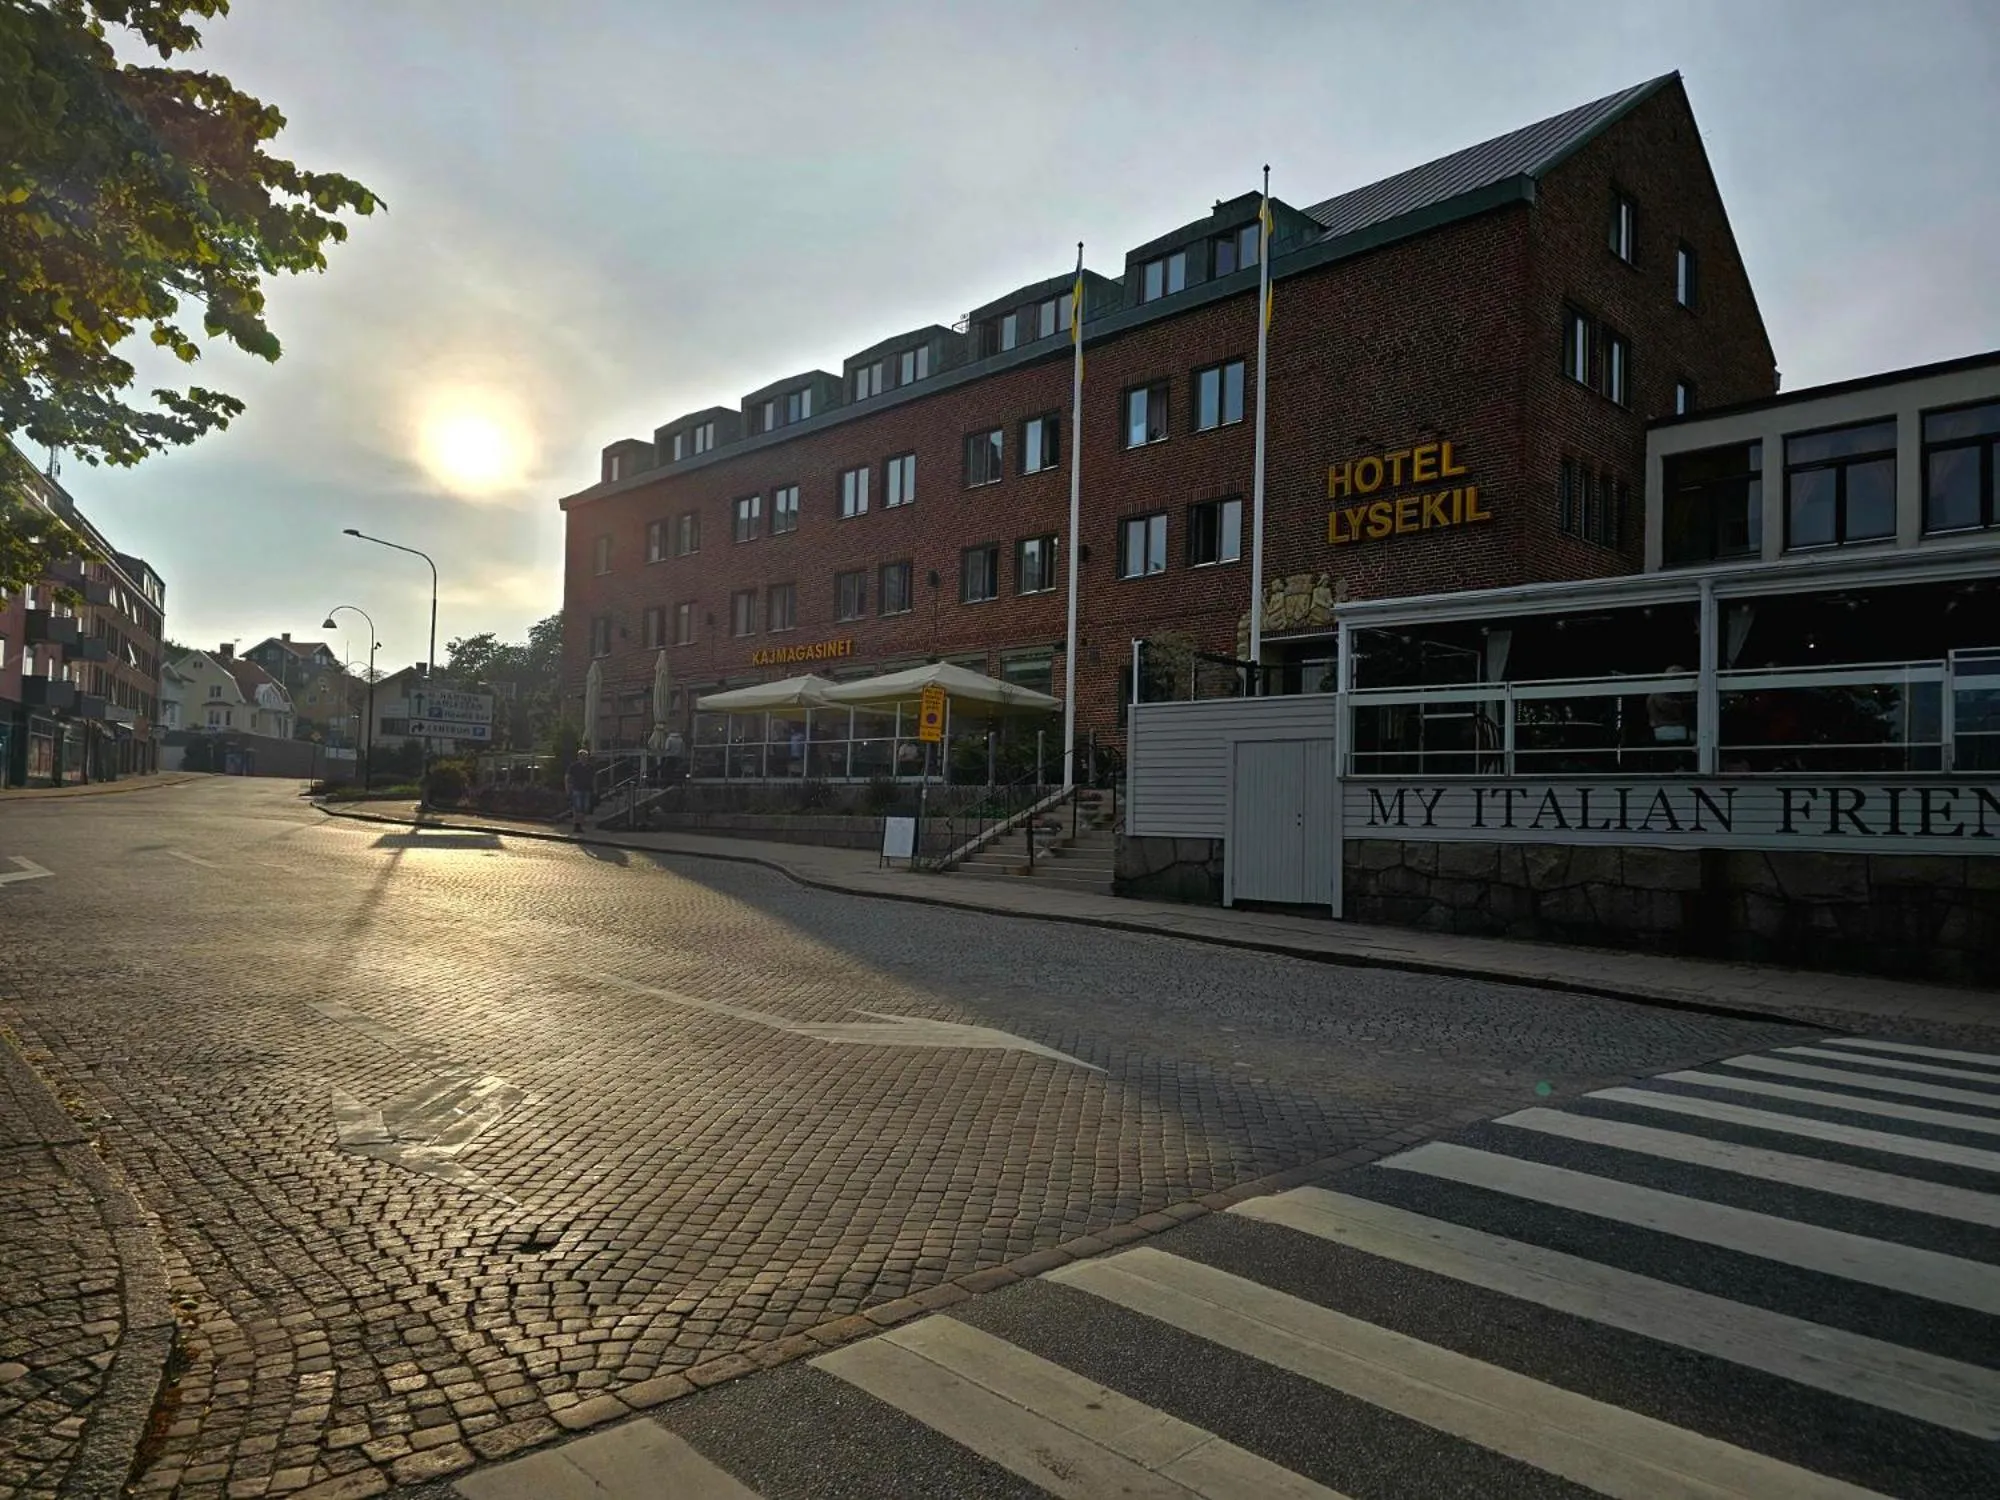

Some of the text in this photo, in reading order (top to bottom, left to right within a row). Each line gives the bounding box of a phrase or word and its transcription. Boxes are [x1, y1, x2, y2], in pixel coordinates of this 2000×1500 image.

[1328, 440, 1469, 499] HOTEL
[1328, 485, 1493, 545] LYSEKIL
[752, 639, 853, 666] KAJMAGASINET
[1366, 787, 1448, 827] MY
[1470, 787, 1738, 833] ITALIAN
